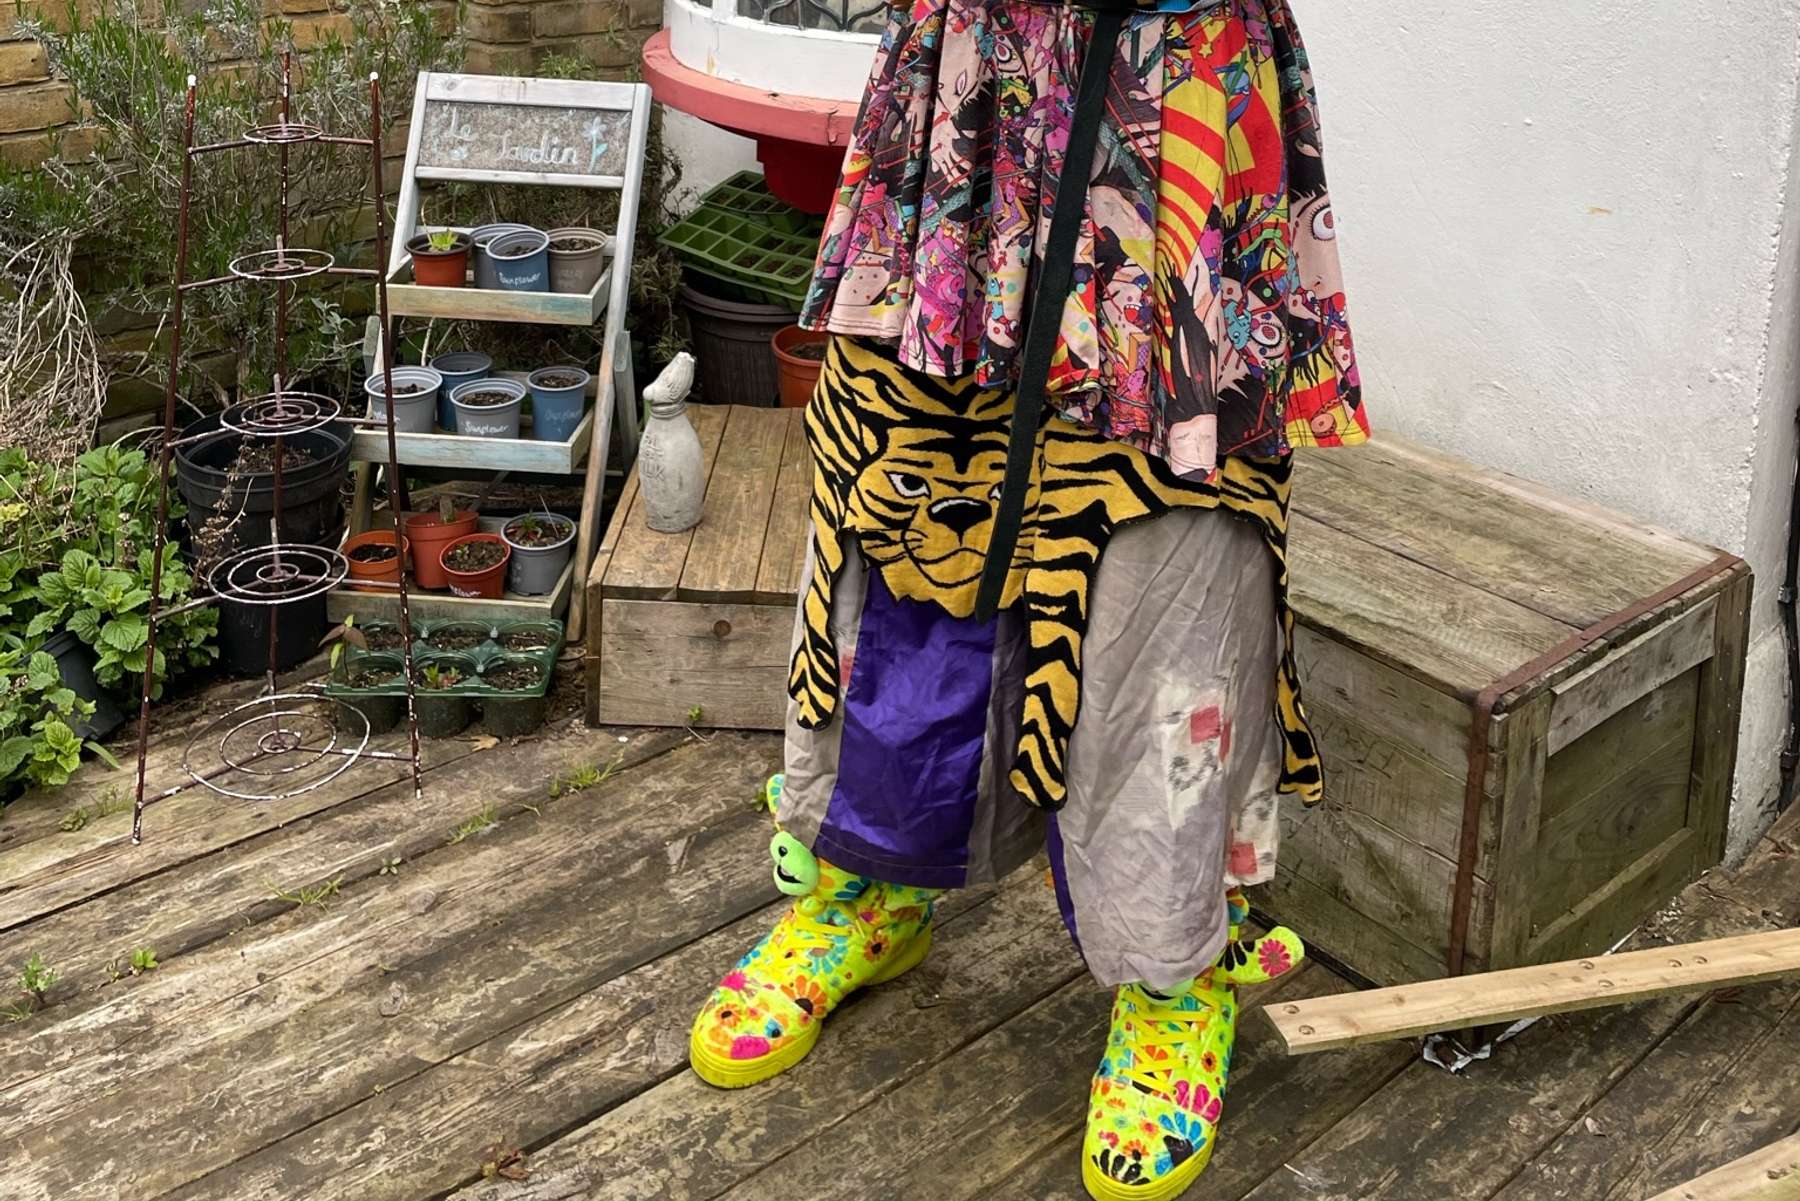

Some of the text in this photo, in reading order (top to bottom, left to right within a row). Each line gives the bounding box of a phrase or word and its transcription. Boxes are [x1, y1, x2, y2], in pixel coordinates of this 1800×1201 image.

[443, 106, 480, 142] Le
[488, 129, 579, 166] Jardin
[498, 272, 543, 286] Sunflower
[464, 419, 511, 436] Sunflower
